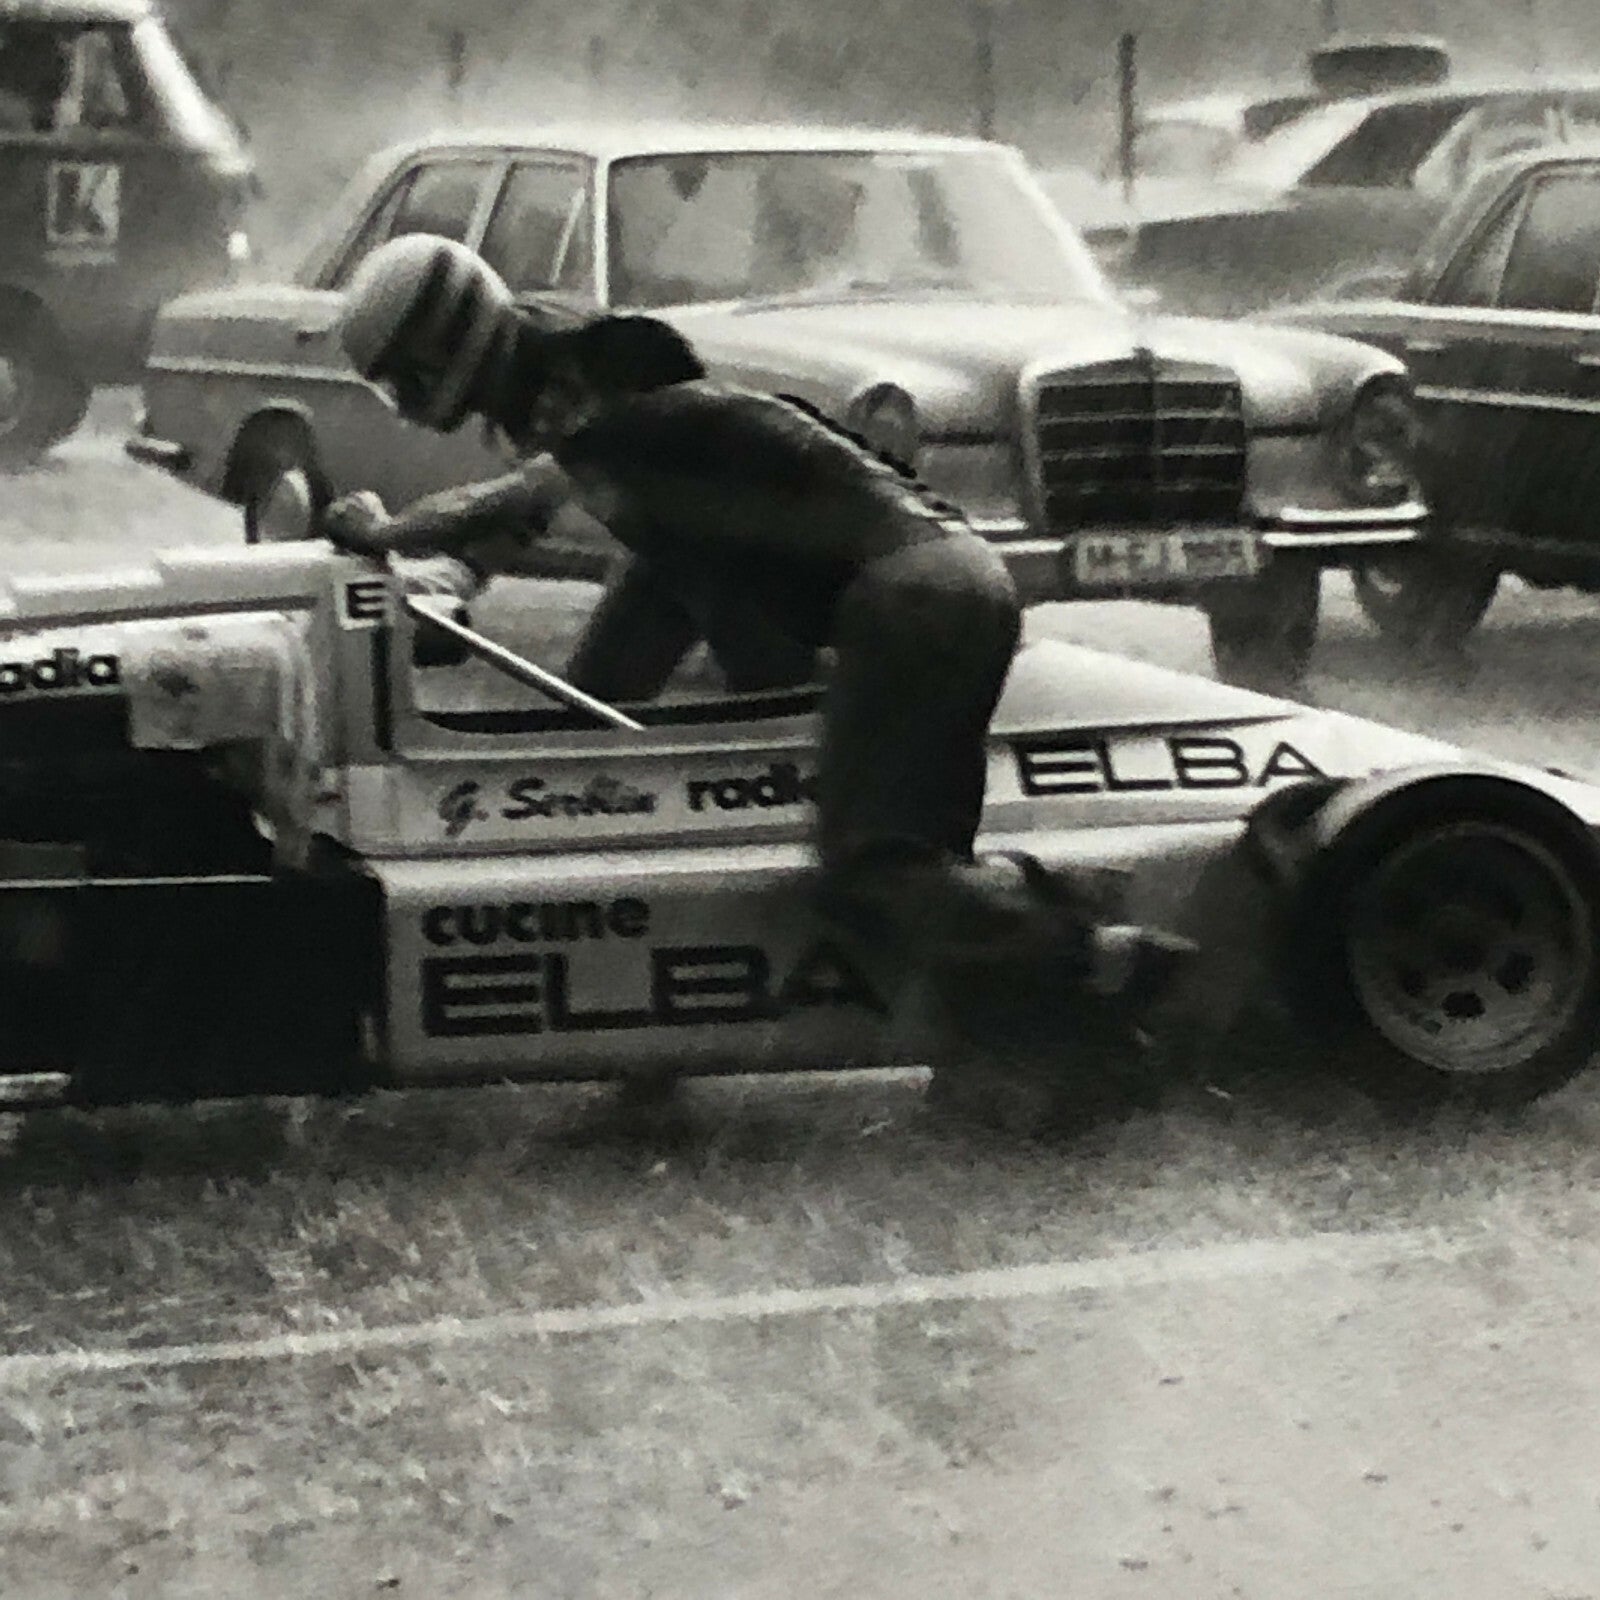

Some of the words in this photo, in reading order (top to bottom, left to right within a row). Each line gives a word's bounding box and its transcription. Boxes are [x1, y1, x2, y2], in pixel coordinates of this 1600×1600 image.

[346, 582, 385, 618] E
[1014, 736, 1327, 796] ELBA
[421, 897, 651, 946] cucine
[420, 944, 890, 1038] ELBA
